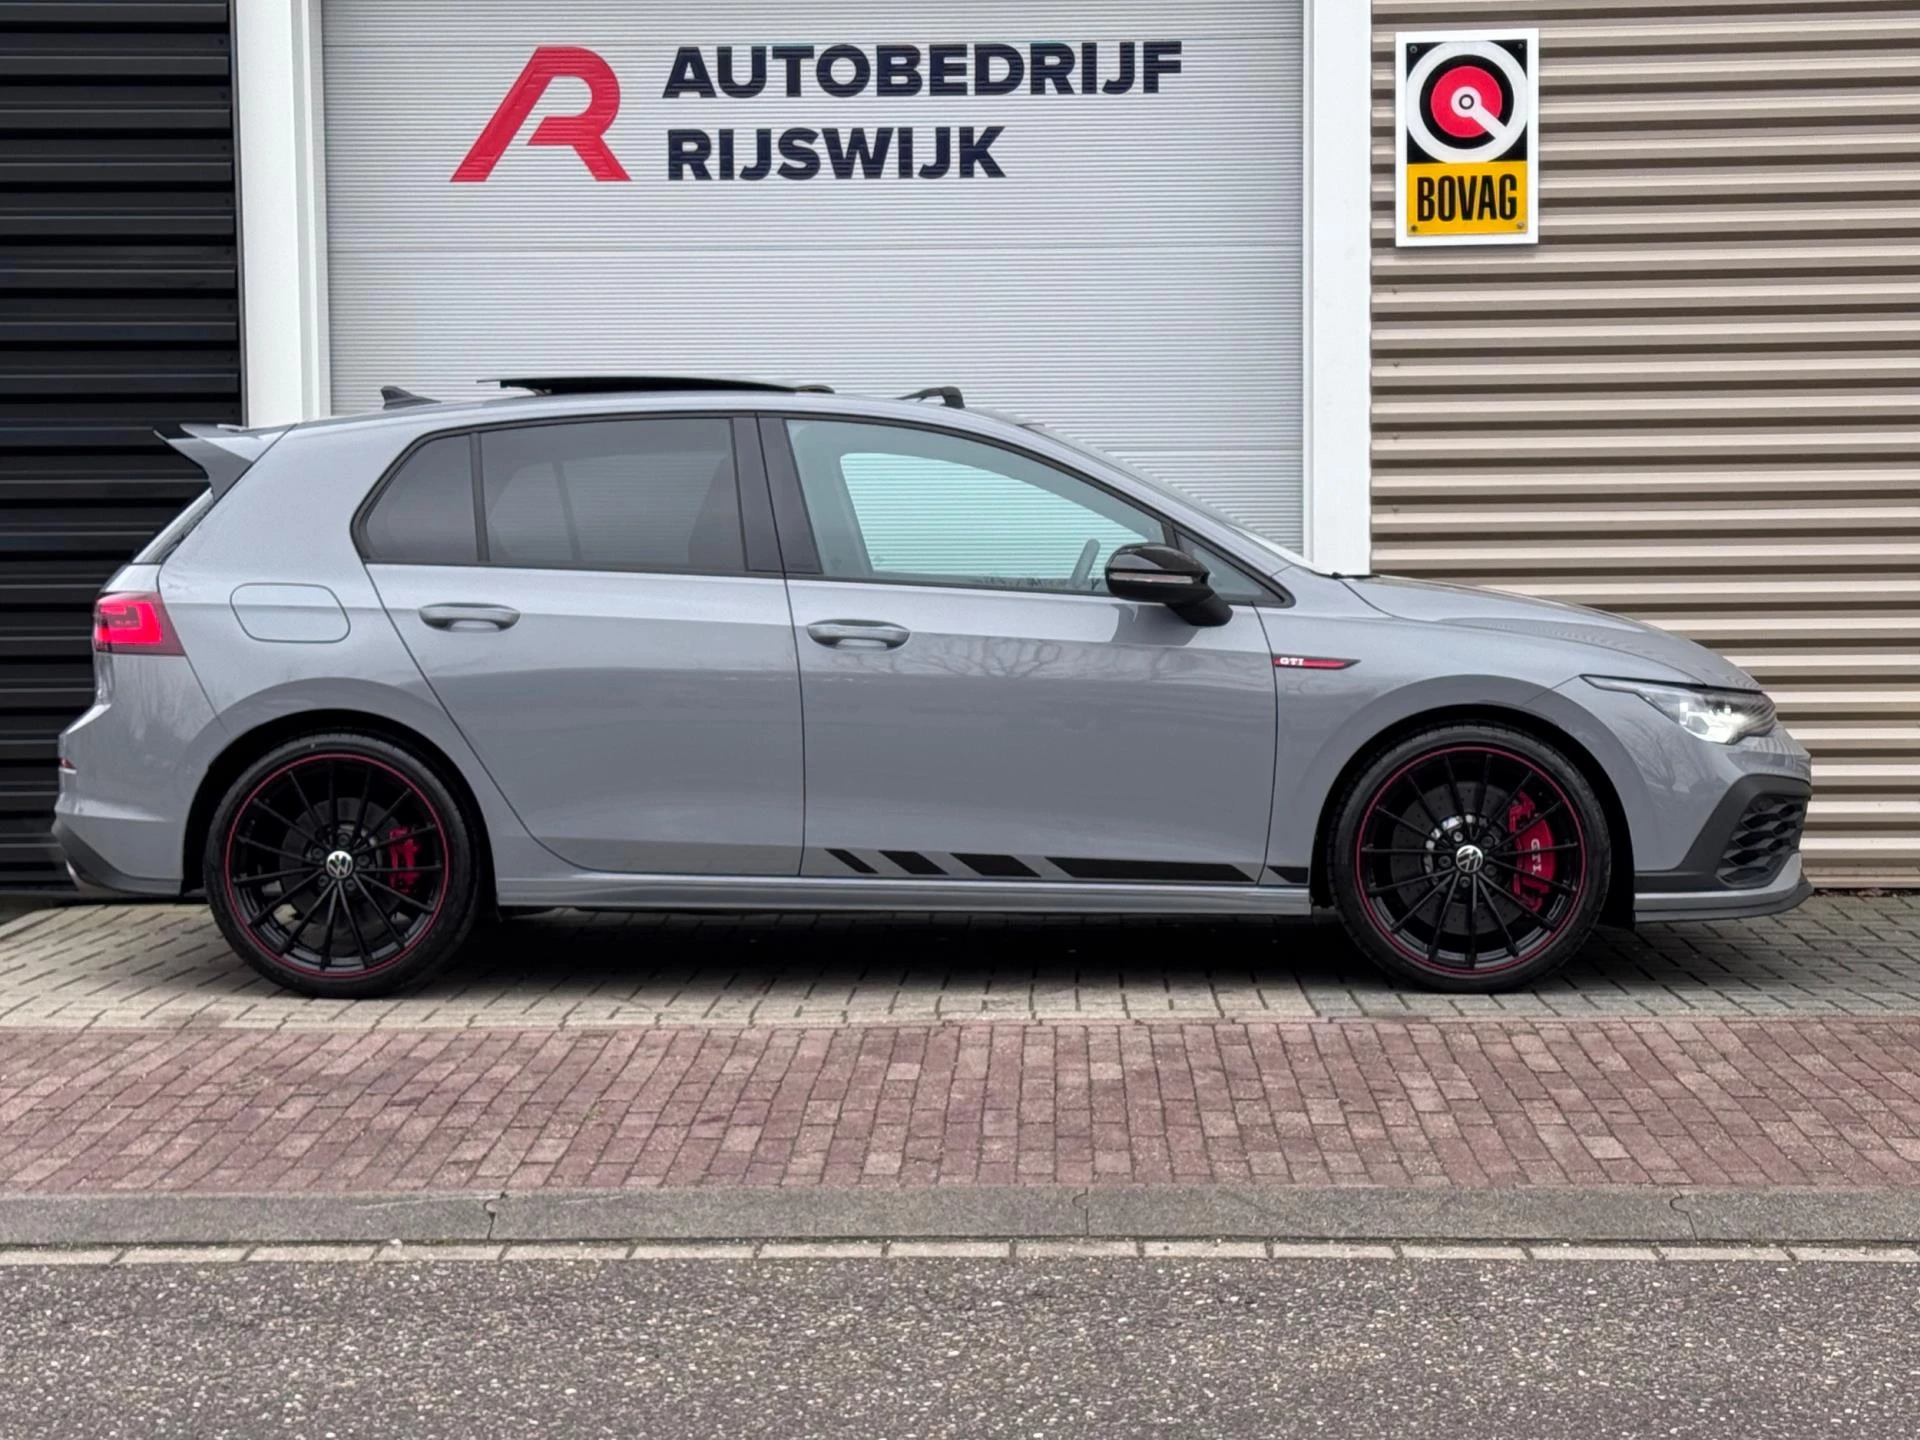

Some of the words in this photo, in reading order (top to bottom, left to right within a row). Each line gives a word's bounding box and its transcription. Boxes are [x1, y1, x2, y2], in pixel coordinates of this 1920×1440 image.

[662, 41, 1182, 98] AUTOBEDRIJF
[667, 126, 1006, 181] RIJSWIJK
[1417, 174, 1517, 221] BOVAG
[1280, 657, 1304, 666] GTI
